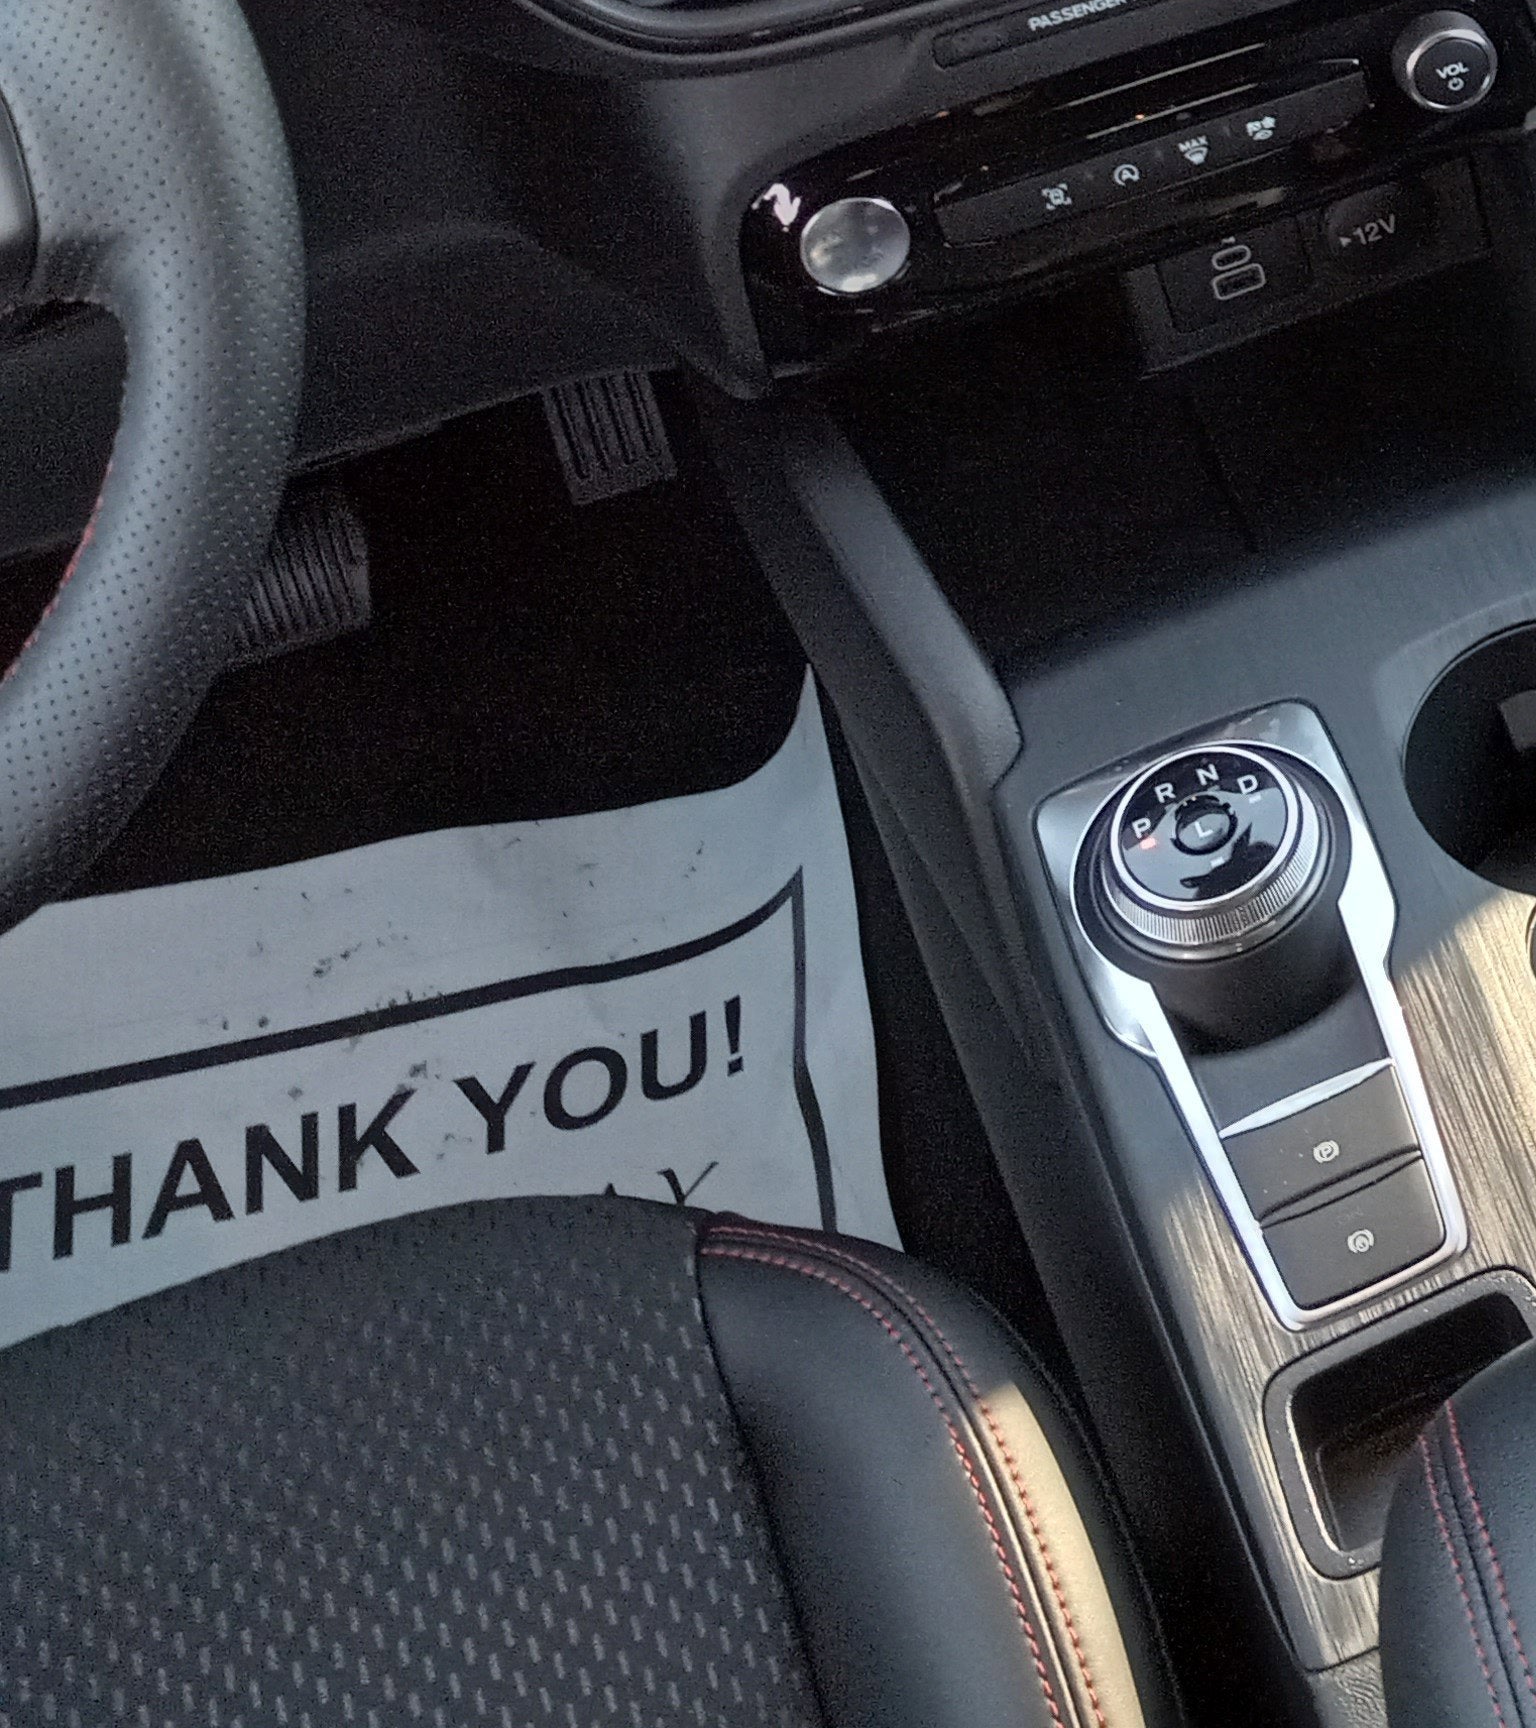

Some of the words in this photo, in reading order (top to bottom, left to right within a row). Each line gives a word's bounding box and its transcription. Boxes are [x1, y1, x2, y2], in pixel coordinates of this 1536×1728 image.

[1435, 60, 1470, 80] VOL
[1177, 135, 1209, 153] MAX
[1351, 212, 1396, 246] 12V
[1194, 763, 1220, 786] N
[1236, 774, 1259, 796] D
[1154, 782, 1177, 804] R
[1131, 817, 1152, 839] P
[1194, 820, 1214, 838] L
[0, 1086, 422, 1273] THANK
[452, 994, 745, 1156] YOU!
